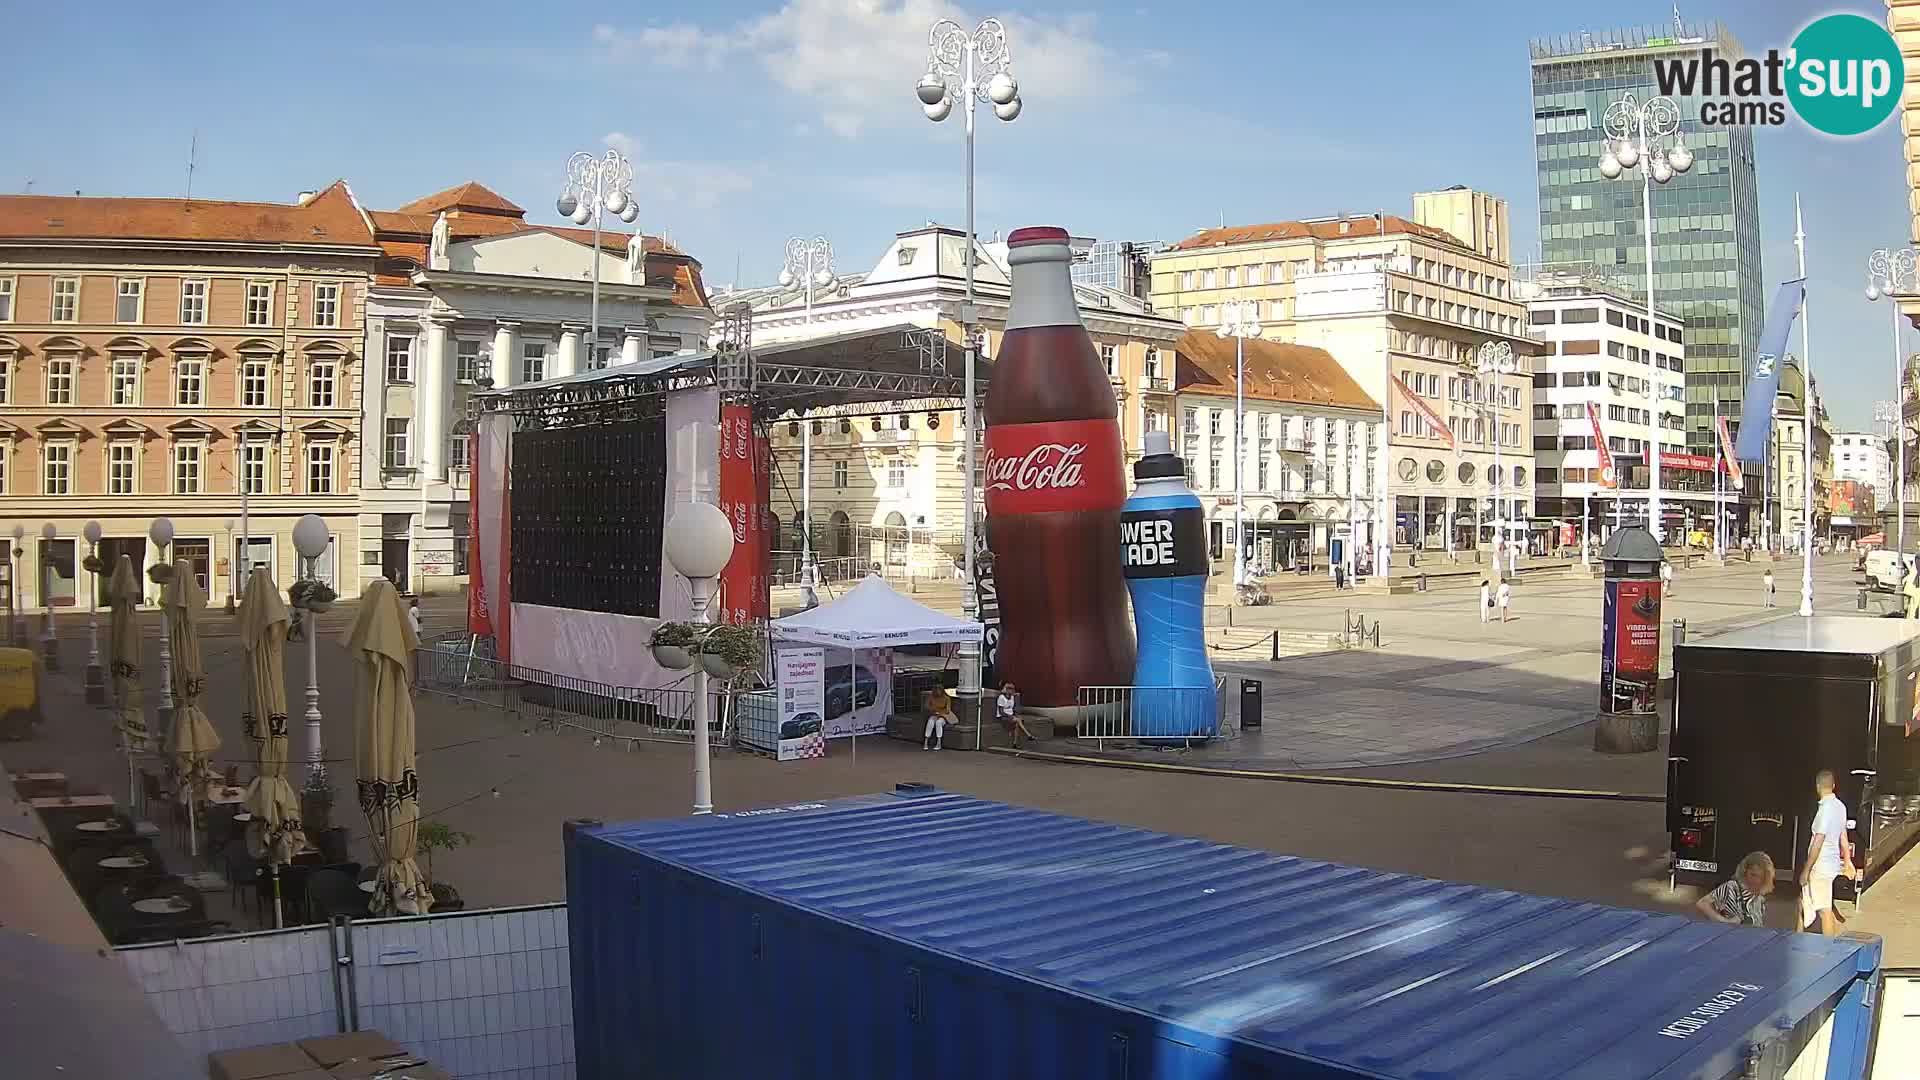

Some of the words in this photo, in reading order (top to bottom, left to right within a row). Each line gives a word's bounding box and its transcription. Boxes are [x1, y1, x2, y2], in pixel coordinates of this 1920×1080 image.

[735, 416, 748, 459] Coca-Cola
[984, 443, 1088, 490] Coca-Cola
[1120, 520, 1173, 544] WER
[1128, 542, 1175, 566] ADE
[1691, 989, 1748, 1018] 300629
